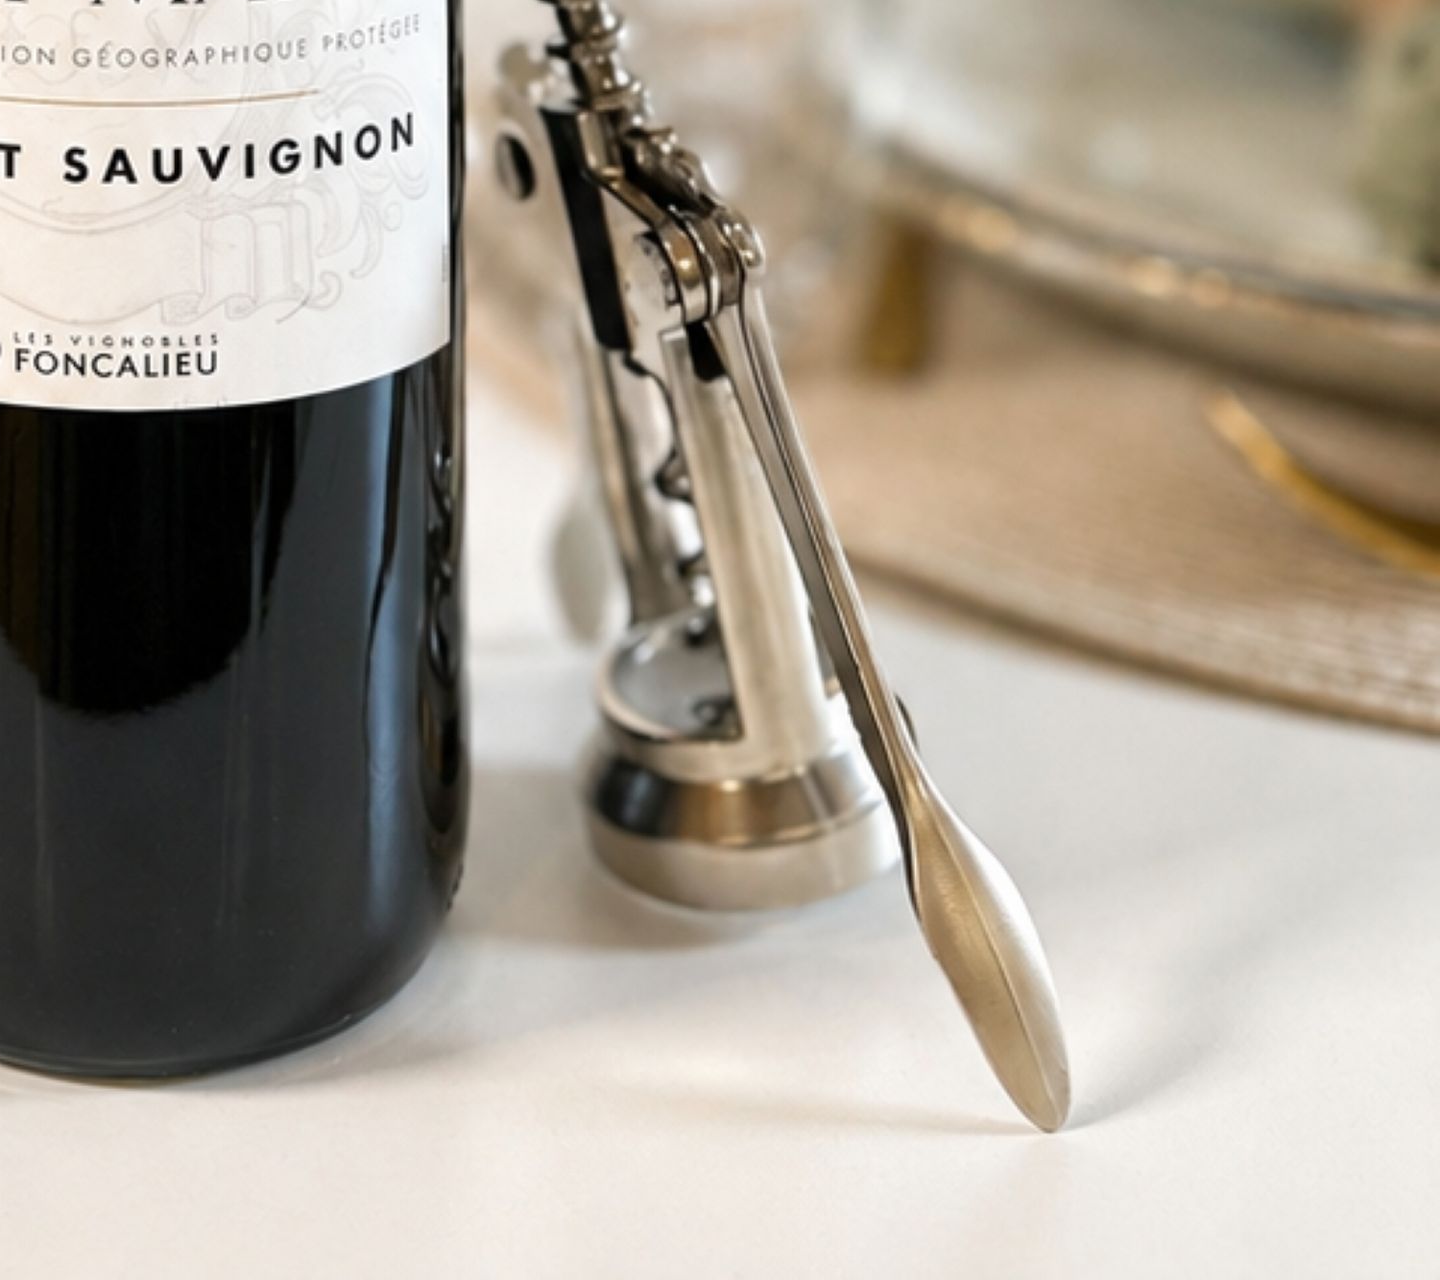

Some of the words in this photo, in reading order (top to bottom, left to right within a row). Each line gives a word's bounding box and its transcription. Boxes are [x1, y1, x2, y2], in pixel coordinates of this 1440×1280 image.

[72, 38, 305, 68] GÉOGRAPHIQUE
[63, 112, 413, 185] SAUVIGNON
[70, 333, 218, 348] VIGNOBLES
[14, 347, 218, 378] FONCALIEU
